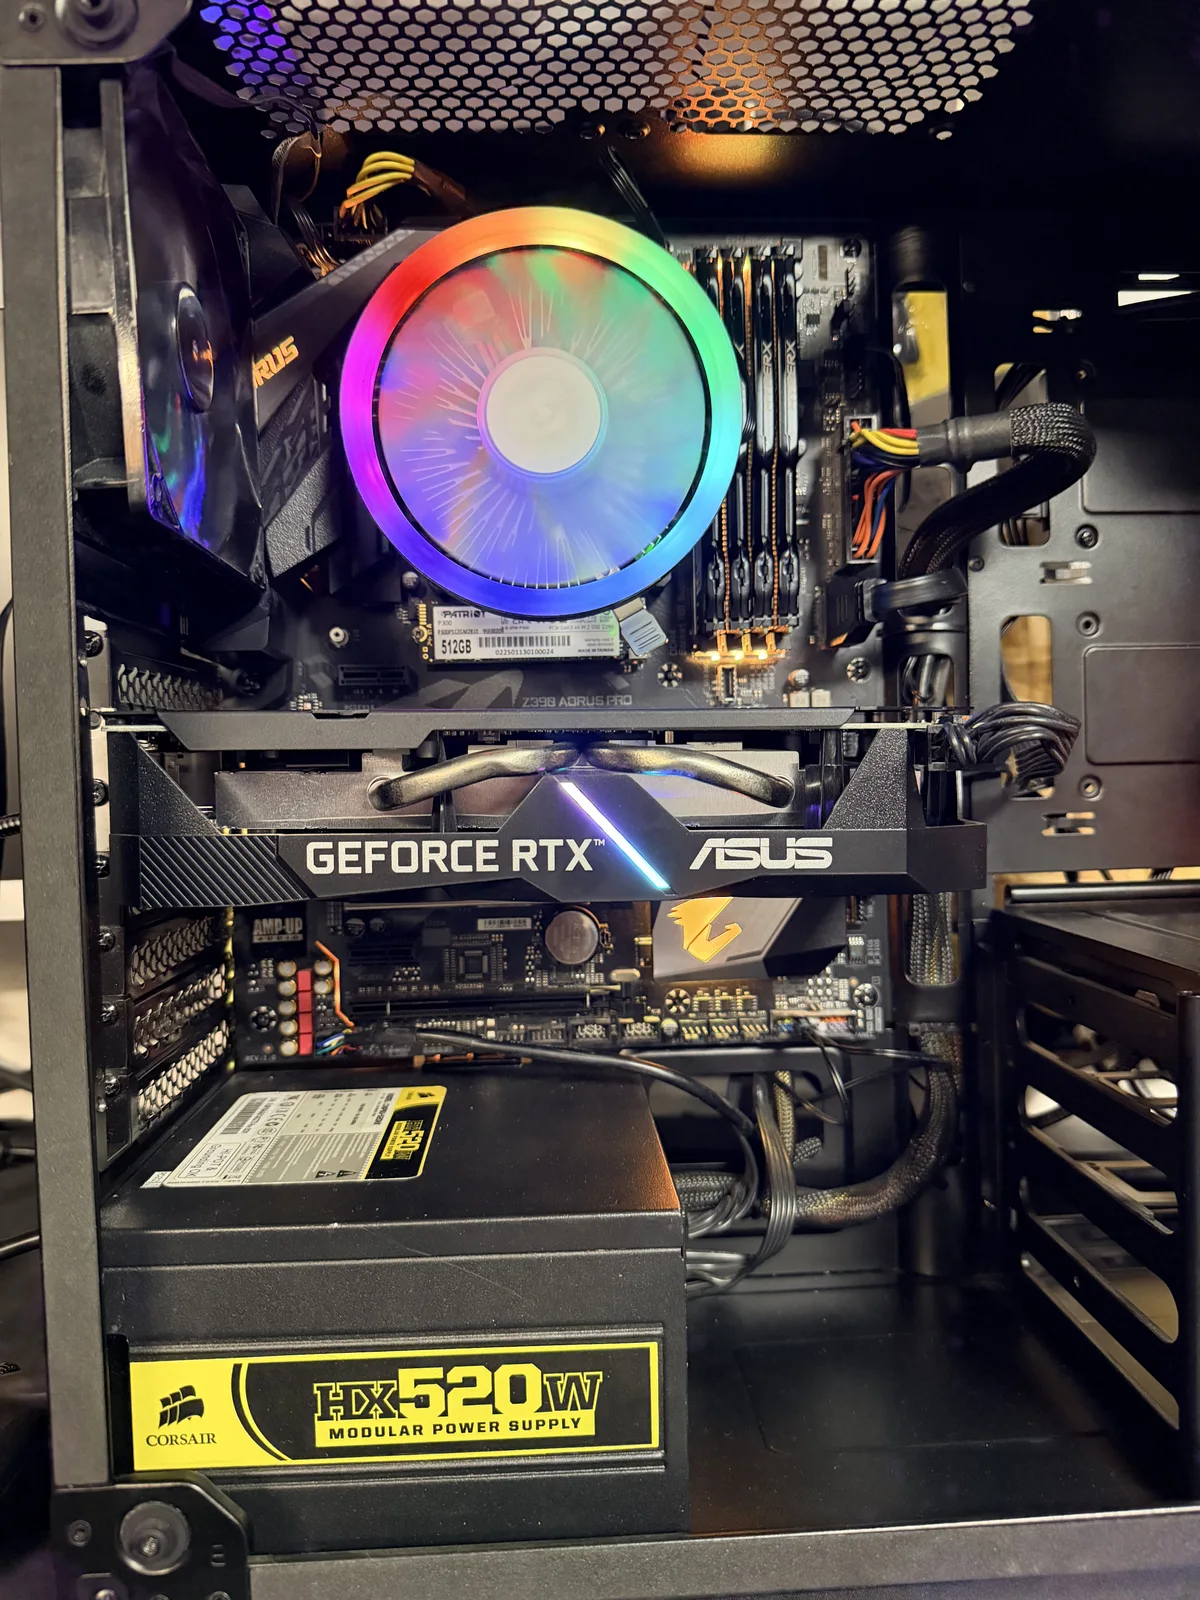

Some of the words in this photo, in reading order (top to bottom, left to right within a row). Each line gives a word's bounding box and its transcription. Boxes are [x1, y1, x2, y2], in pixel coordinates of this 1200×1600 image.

[252, 335, 299, 388] RUS
[441, 639, 472, 654] 512GB
[522, 697, 556, 708] Z390
[558, 695, 604, 707] AORUS
[606, 694, 633, 706] PRO
[306, 839, 499, 875] GEFORCE
[689, 837, 833, 870] ASUS
[253, 917, 303, 935] AMP-UP
[313, 1363, 603, 1422] HX520W
[146, 1432, 217, 1447] CORSAIR
[329, 1425, 424, 1440] MODULAR
[432, 1421, 500, 1435] POWER
[508, 1417, 582, 1432] SUPPLY
